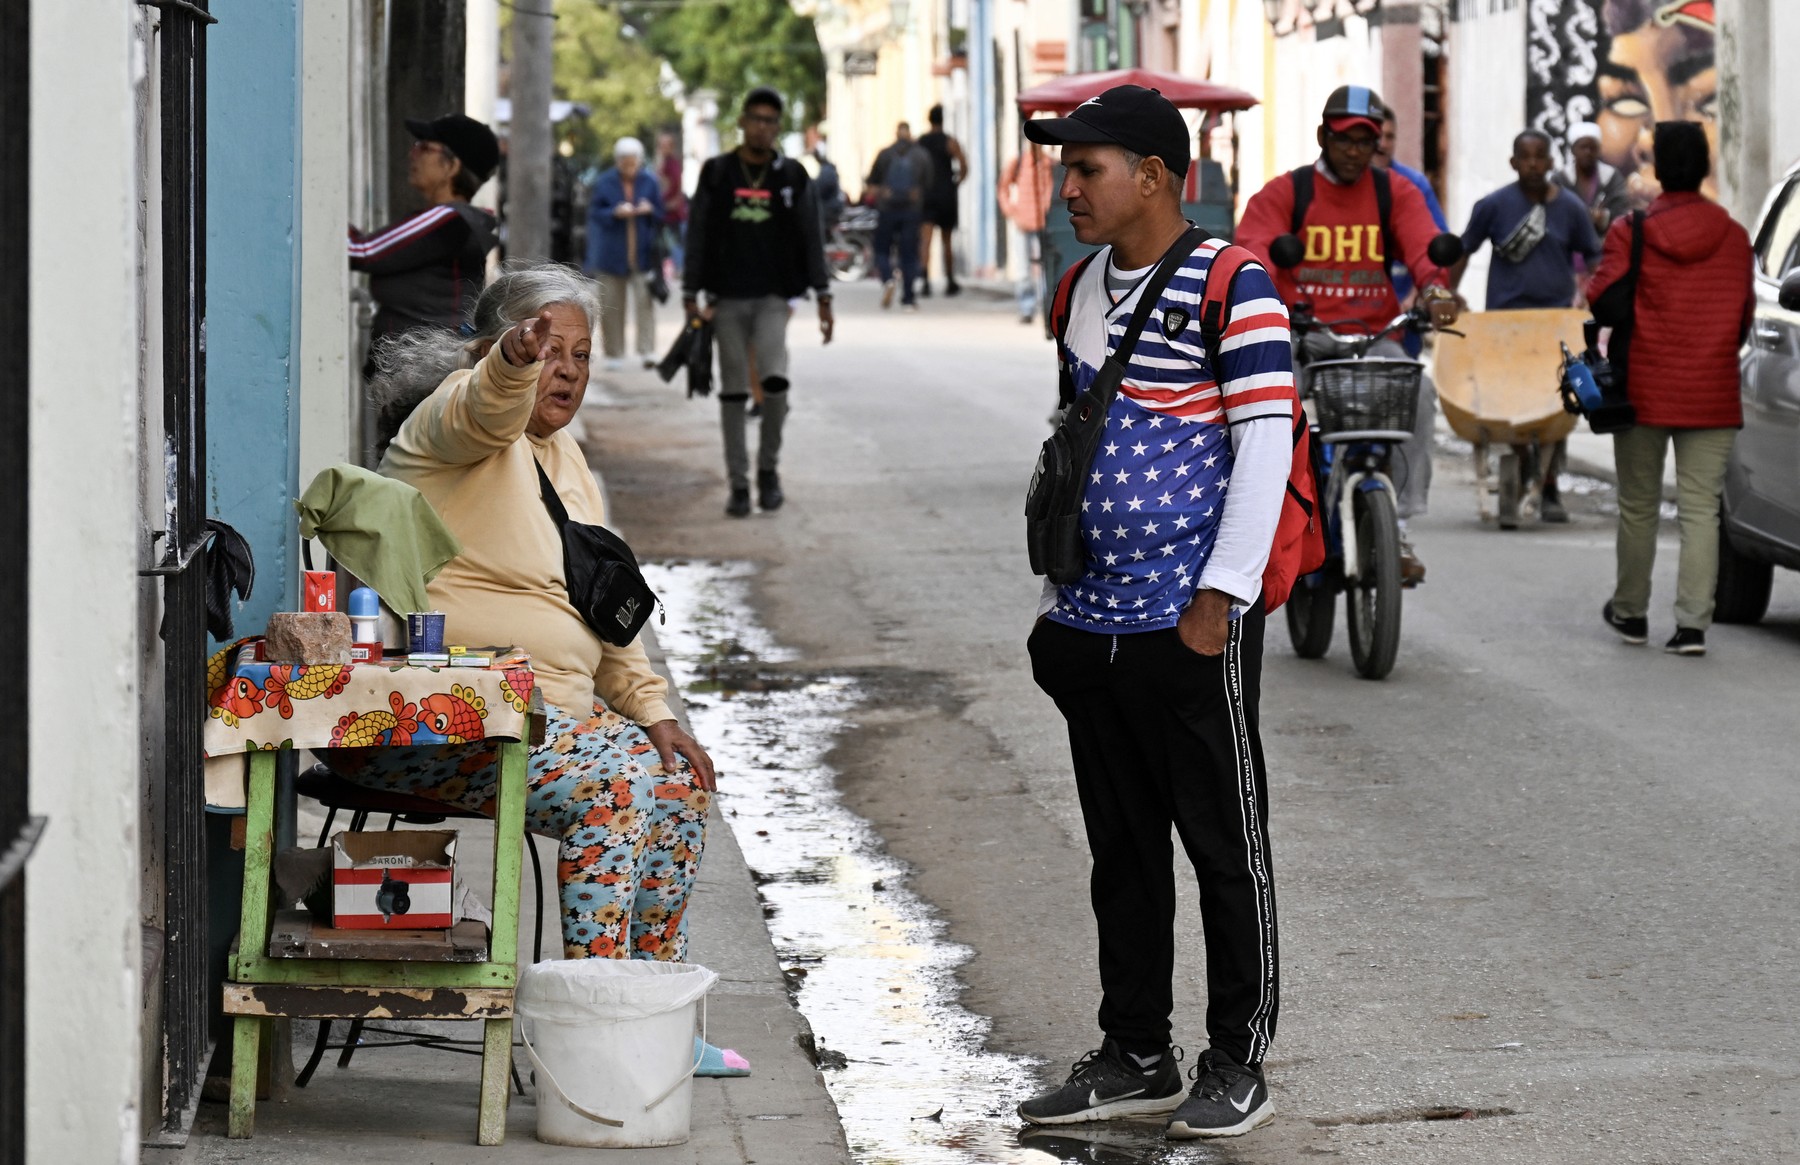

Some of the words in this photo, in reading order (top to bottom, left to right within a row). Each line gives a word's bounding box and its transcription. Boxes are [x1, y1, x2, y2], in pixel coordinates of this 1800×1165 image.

[1229, 663, 1239, 699] CHARM.
[1243, 759, 1252, 794] CHARM.
[1254, 853, 1266, 886] CHARM.
[1266, 945, 1275, 980] CHARM.
